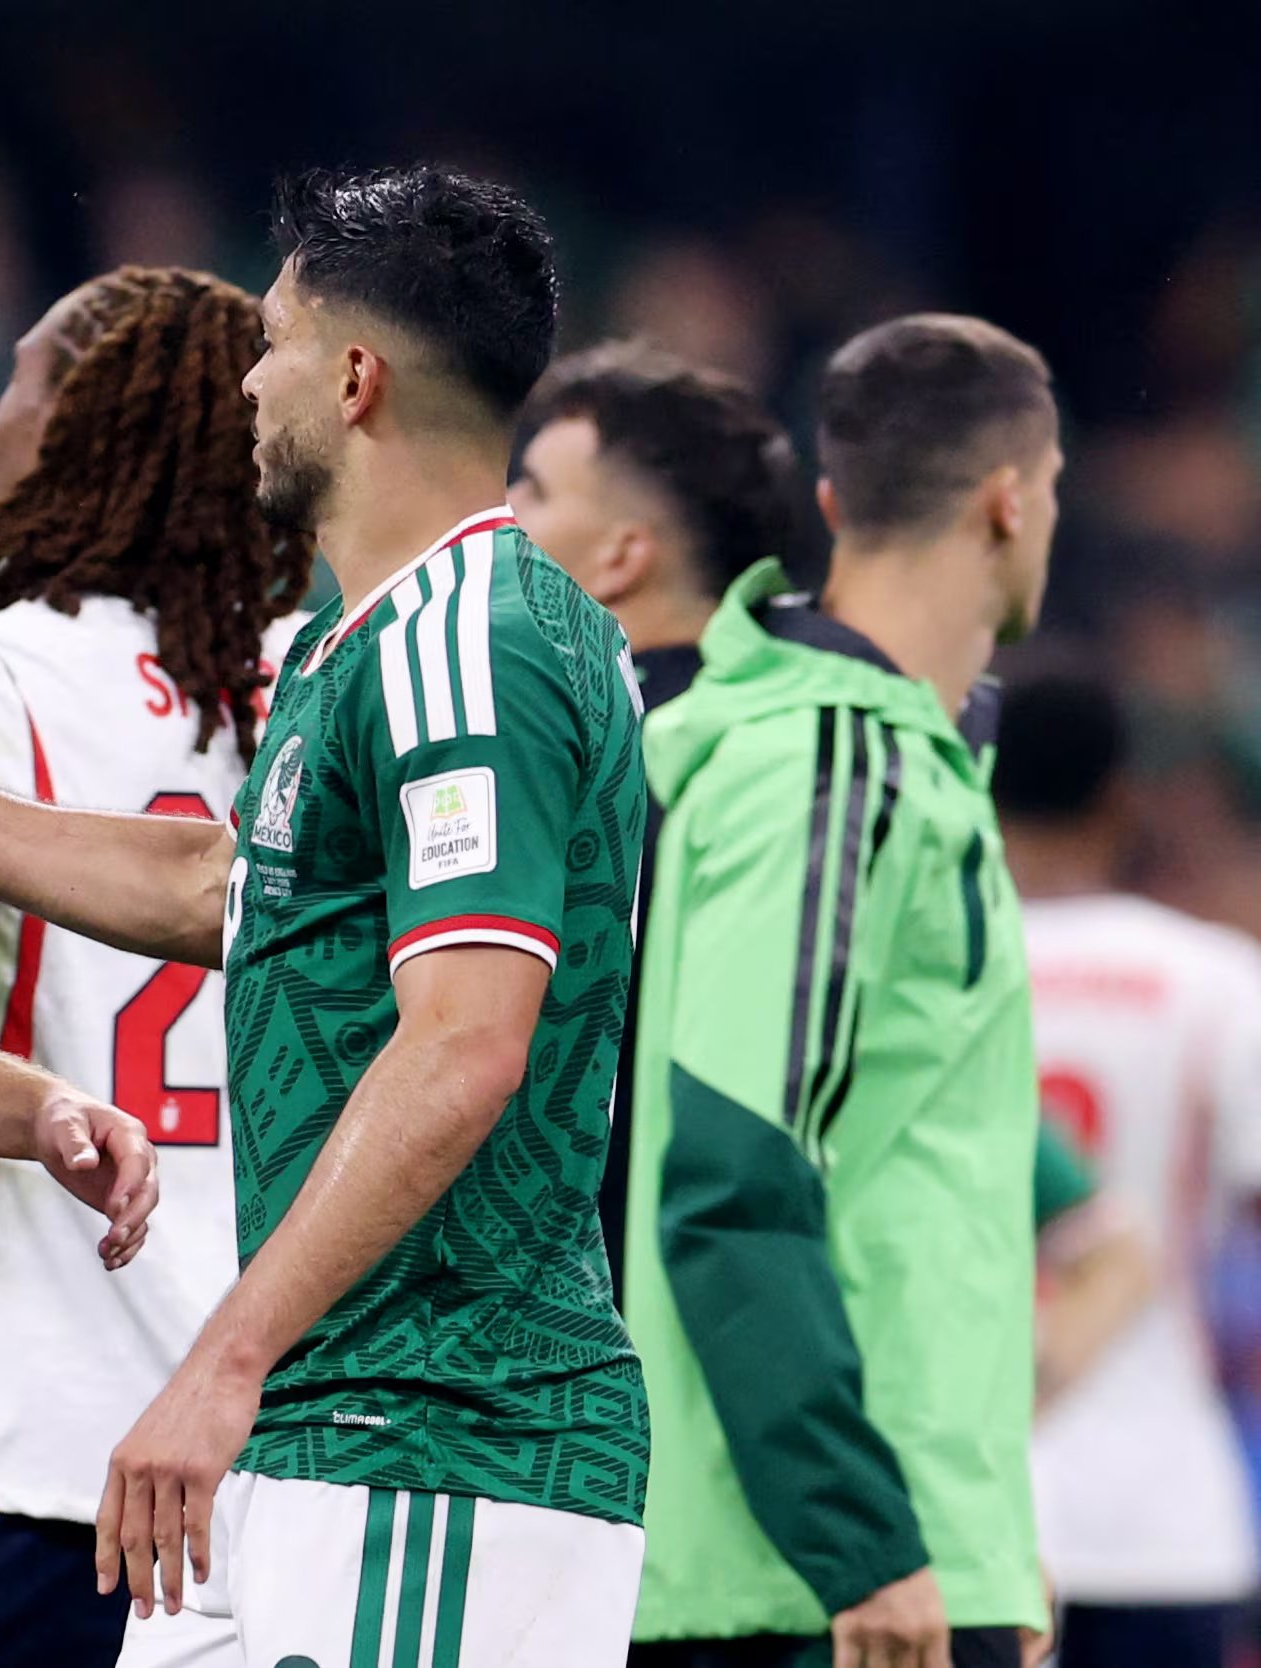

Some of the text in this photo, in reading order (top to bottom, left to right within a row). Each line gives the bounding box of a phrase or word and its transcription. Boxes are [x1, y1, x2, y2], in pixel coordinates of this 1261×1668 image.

[427, 816, 472, 842] Unite For
[421, 835, 479, 863] EDUCATION
[438, 857, 459, 870] FIFA
